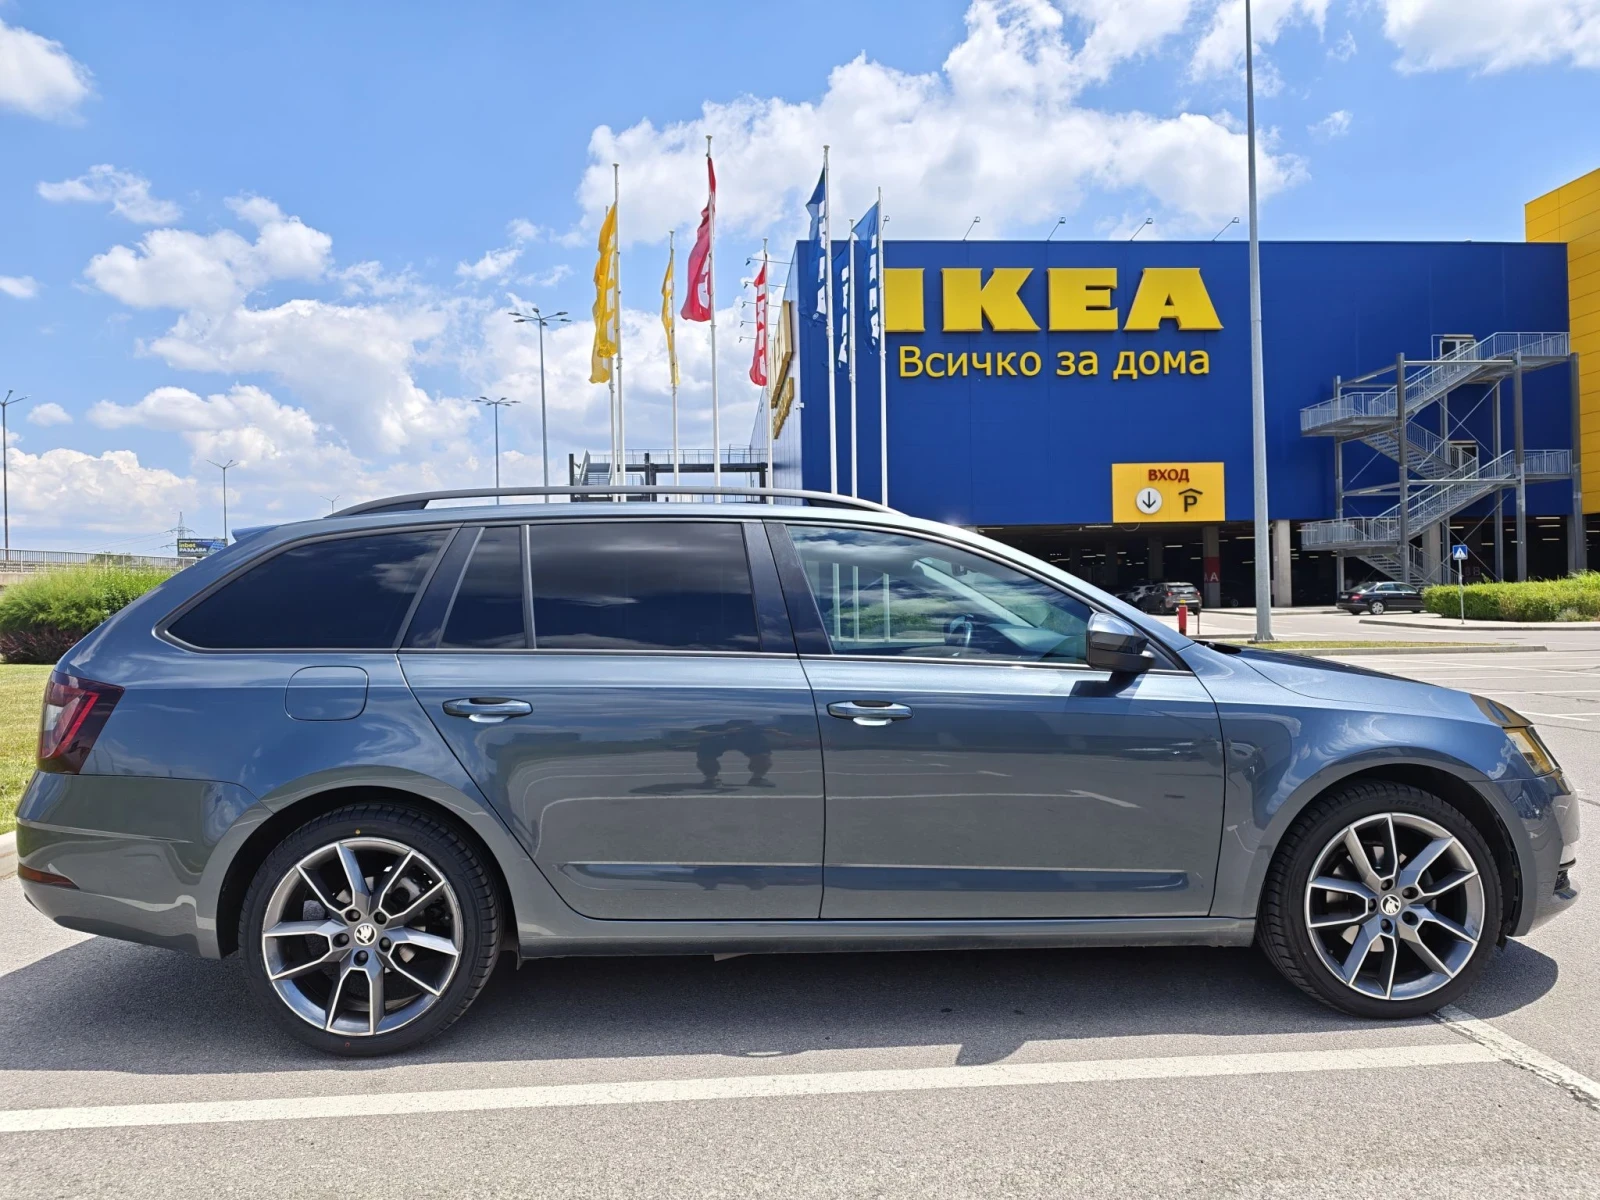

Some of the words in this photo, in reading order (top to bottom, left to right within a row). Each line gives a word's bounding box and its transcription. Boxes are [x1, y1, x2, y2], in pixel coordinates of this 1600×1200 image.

[883, 267, 1223, 332] IKEA
[900, 345, 1042, 378] Всичко
[1056, 350, 1099, 376] за
[1113, 350, 1210, 380] дома
[1148, 468, 1190, 483] ВХОД
[1184, 495, 1197, 512] P
[1210, 572, 1219, 582] A
